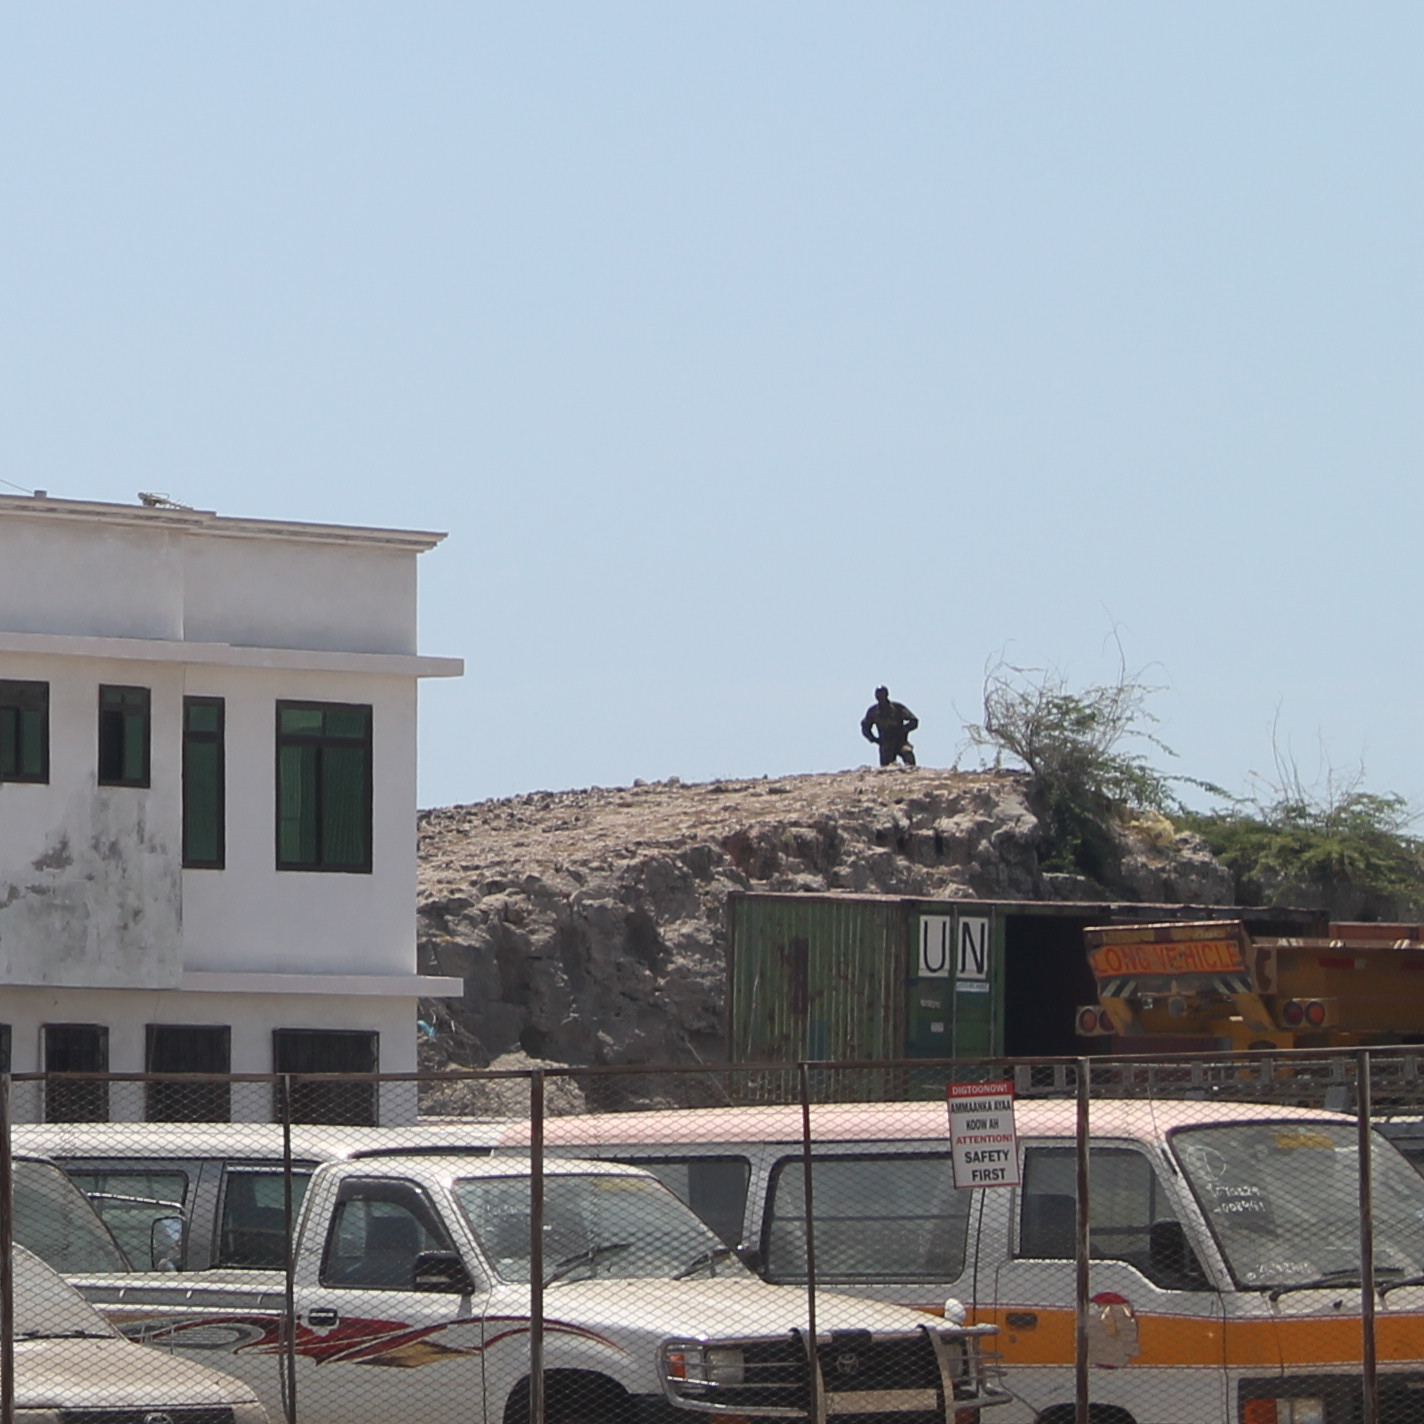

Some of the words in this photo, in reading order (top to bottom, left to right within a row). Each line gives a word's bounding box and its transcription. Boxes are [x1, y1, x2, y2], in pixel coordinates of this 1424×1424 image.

[923, 920, 986, 974] UN
[1091, 945, 1151, 974] LONG
[1154, 941, 1239, 971] VEHICLE
[952, 1084, 1008, 1095] DIGTOONOW!
[951, 1101, 992, 1114] AMMAANKA
[994, 1100, 1011, 1112] AYAA
[966, 1118, 987, 1131] KOOW
[989, 1118, 999, 1130] AH
[956, 1134, 1013, 1145] ATTENTION!
[964, 1150, 1010, 1164] SAFETY
[972, 1168, 1006, 1182] FIRST
